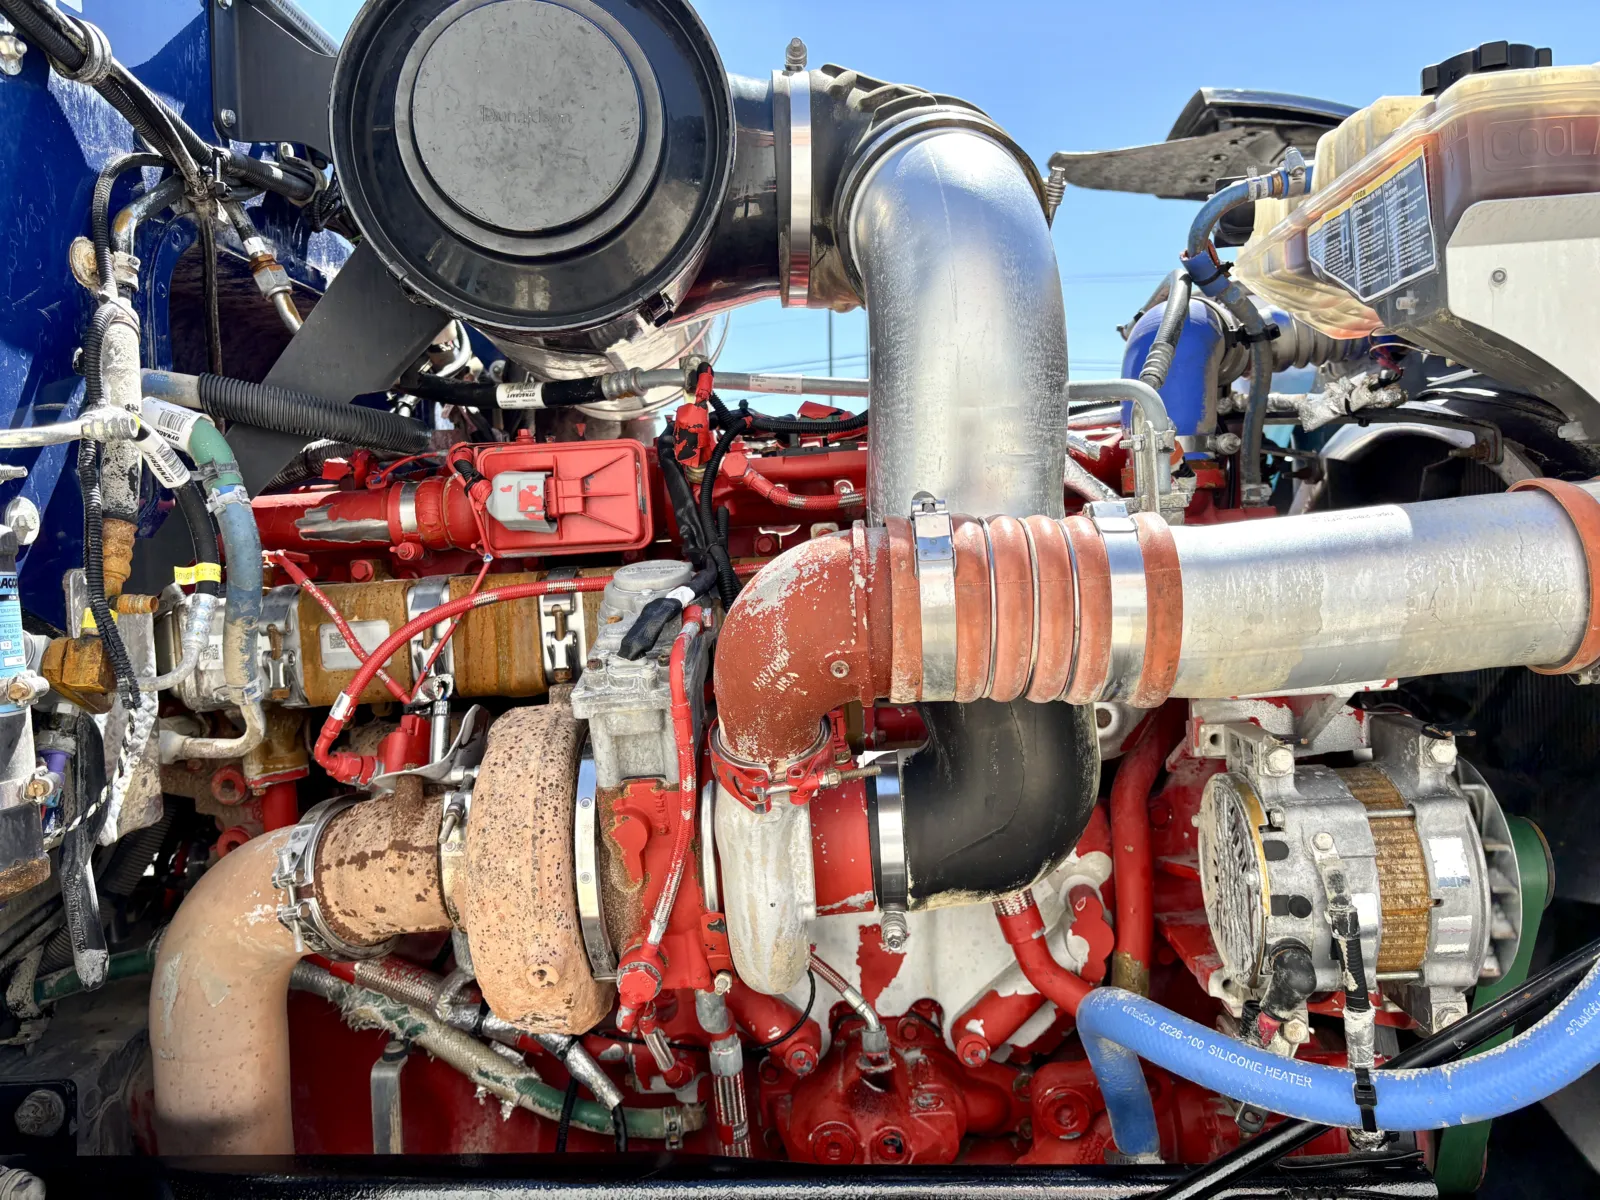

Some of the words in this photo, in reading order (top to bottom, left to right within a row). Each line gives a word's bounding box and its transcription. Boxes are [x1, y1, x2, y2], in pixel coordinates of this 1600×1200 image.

[478, 103, 573, 125] Donaldson
[1491, 120, 1600, 162] COOL
[1158, 1022, 1205, 1050] 5526-100
[1208, 1044, 1262, 1075] SILICONE
[1264, 1065, 1313, 1089] HEATER
